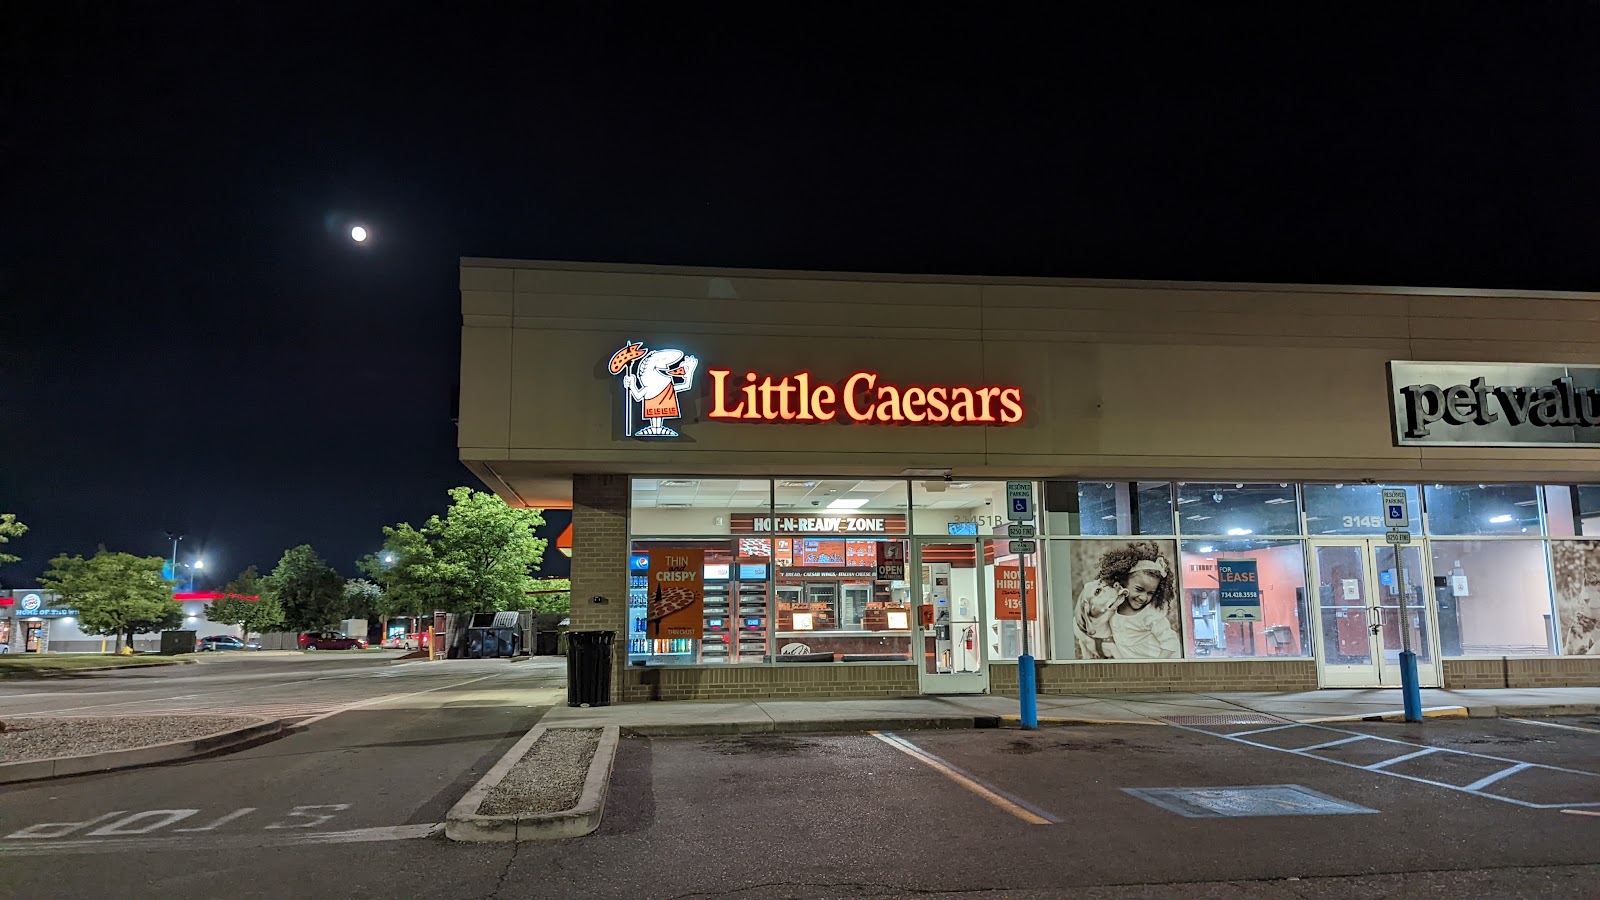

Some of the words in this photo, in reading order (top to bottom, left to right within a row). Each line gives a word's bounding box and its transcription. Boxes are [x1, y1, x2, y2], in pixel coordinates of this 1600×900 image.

[708, 368, 836, 421] Little
[842, 371, 1023, 423] Caesars
[754, 518, 840, 532] HOT-N-READY
[847, 518, 884, 532] ZONE
[953, 515, 1003, 527] 31451B
[665, 556, 688, 566] THIN
[879, 566, 902, 575] OPEN
[656, 572, 697, 582] CRISPY
[1220, 572, 1256, 582] LEASE
